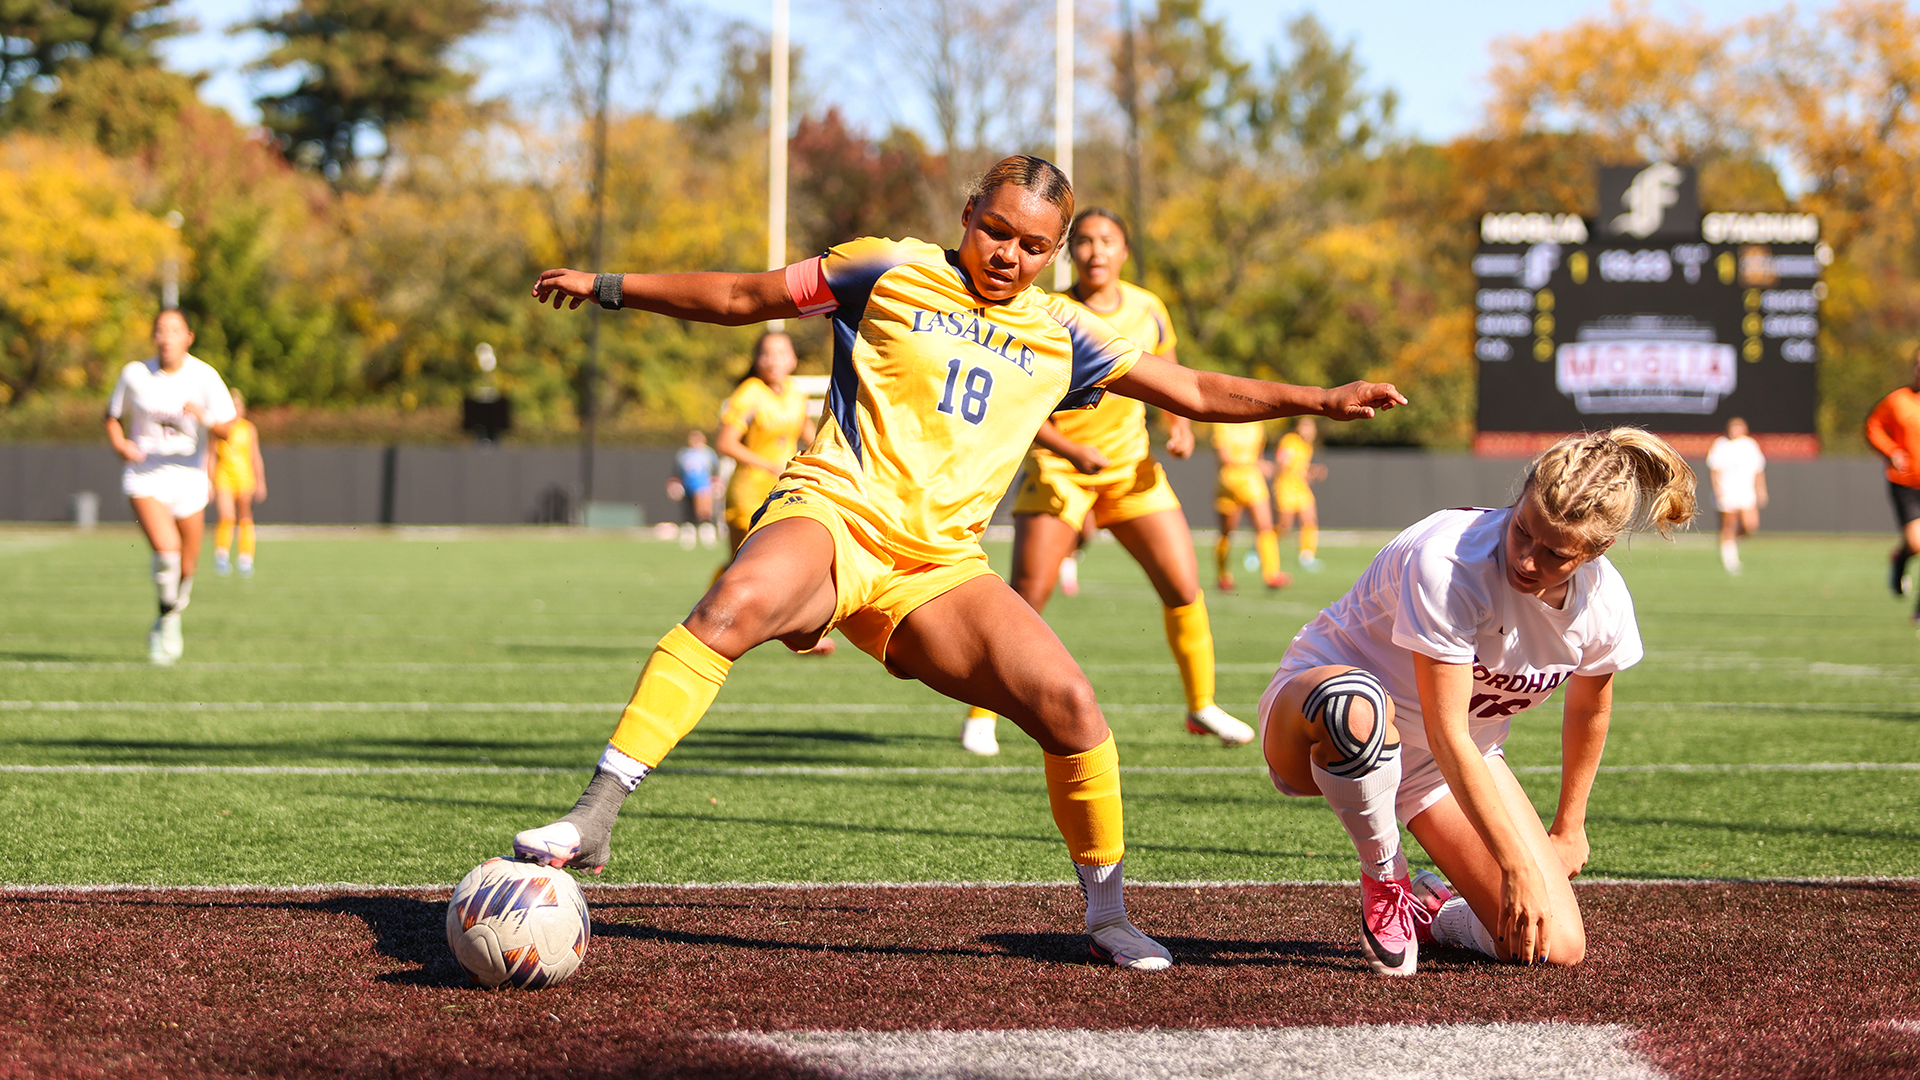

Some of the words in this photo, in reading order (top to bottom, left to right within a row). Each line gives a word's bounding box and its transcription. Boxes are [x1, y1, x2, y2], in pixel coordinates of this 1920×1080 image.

[1702, 212, 1819, 243] STADIUM
[1563, 346, 1729, 386] MOGLIA
[937, 358, 994, 426] 18
[1473, 654, 1573, 693] ORDHA
